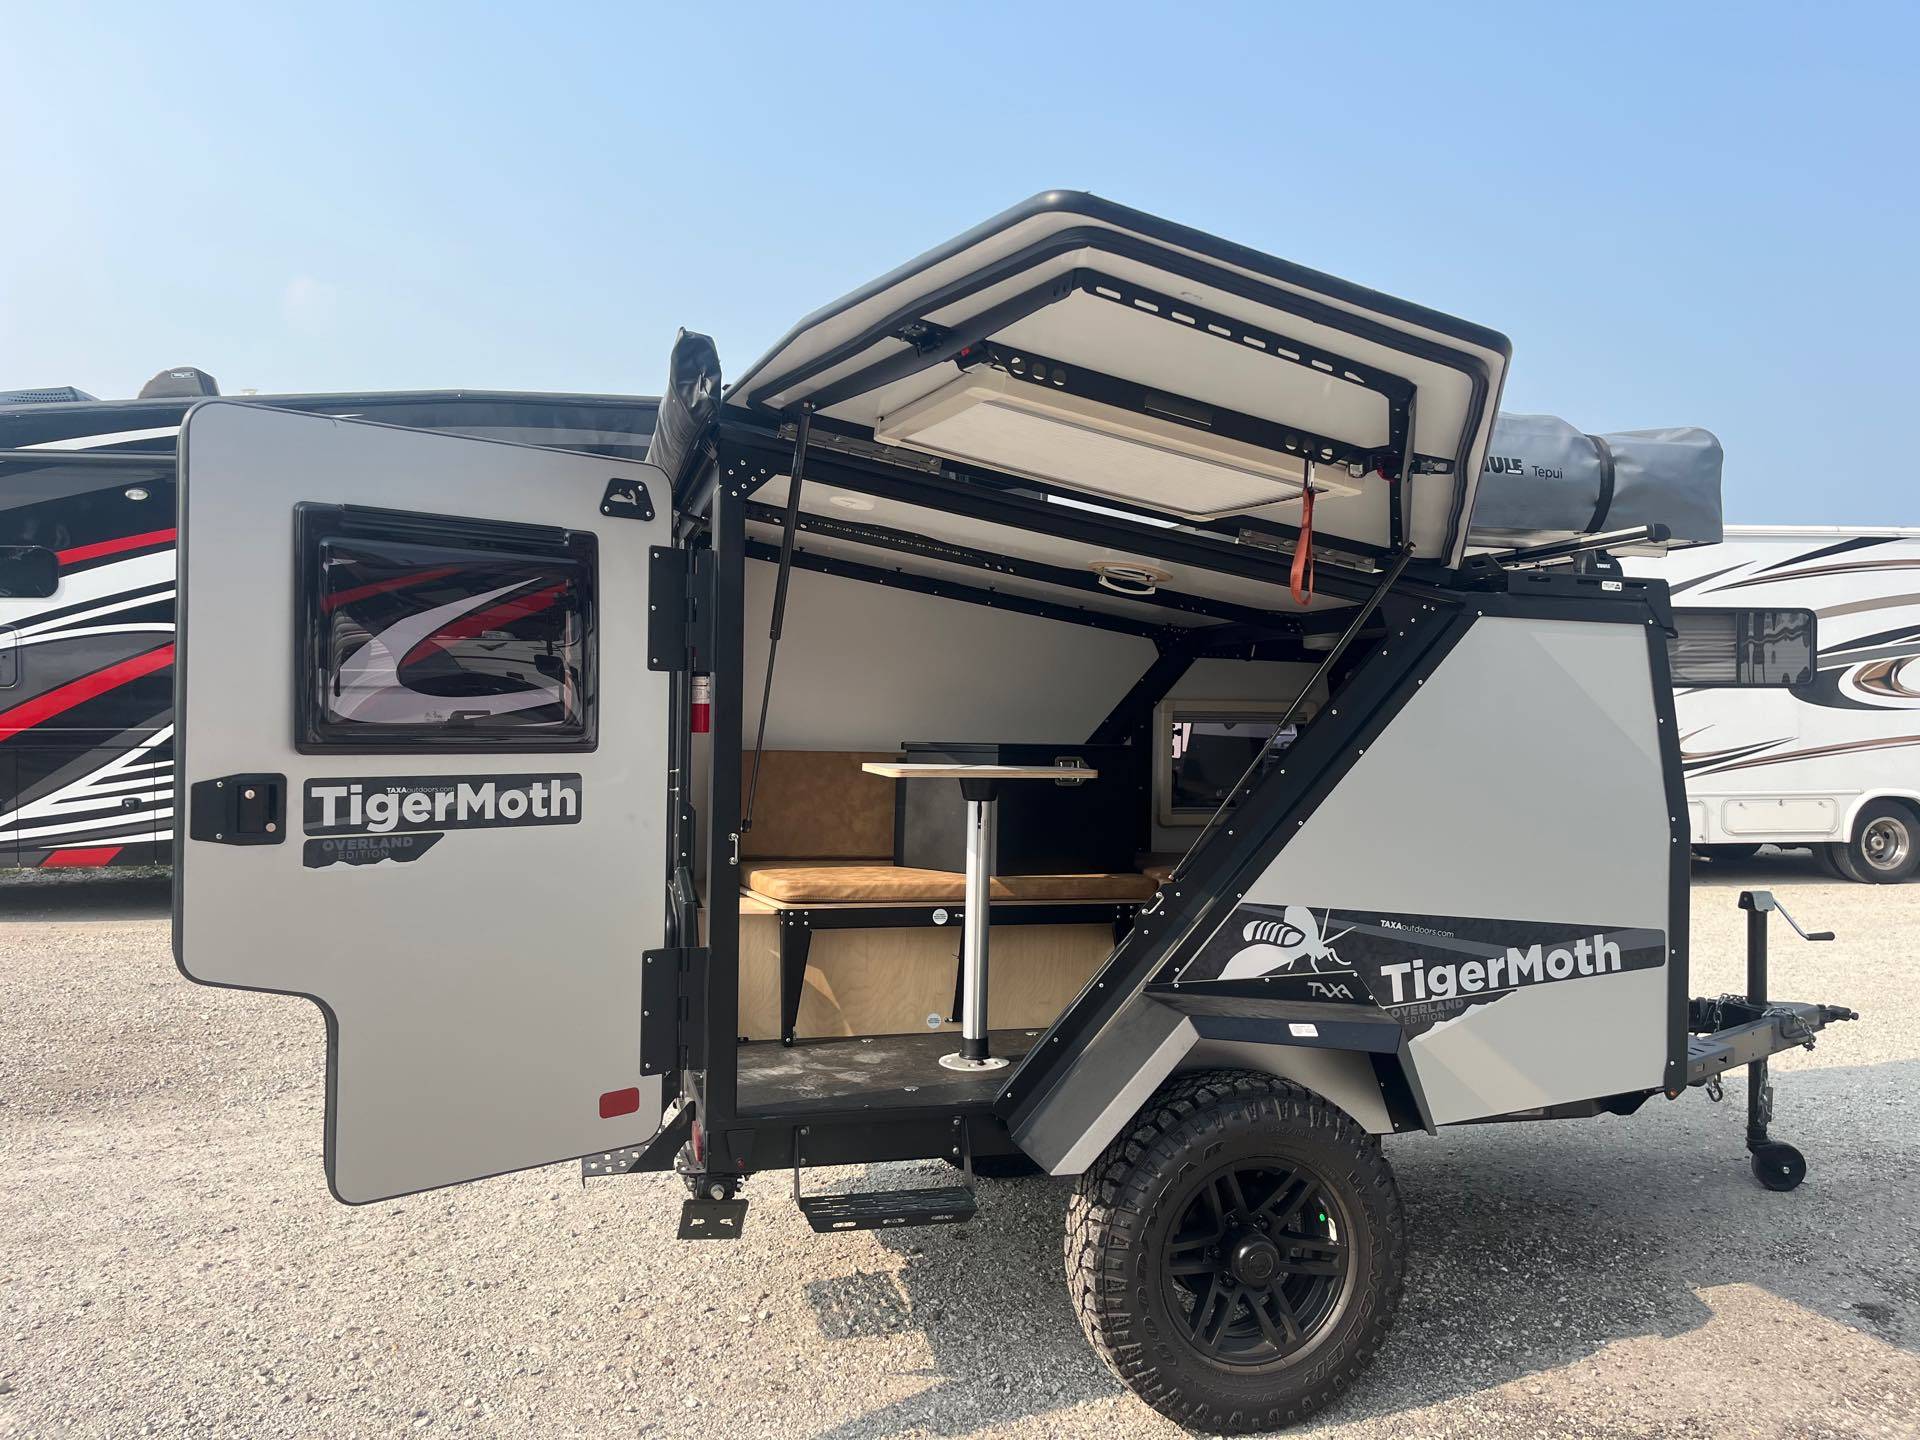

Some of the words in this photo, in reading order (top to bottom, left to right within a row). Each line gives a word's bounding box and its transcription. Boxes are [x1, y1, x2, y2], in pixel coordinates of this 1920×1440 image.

[1485, 456, 1523, 475] ULE
[1531, 465, 1563, 480] Tepui
[386, 786, 455, 794] TAXAoutdoors.com
[311, 779, 577, 832] TigerMoth
[322, 836, 413, 851] OVERLAND
[338, 849, 390, 860] EDITION
[1380, 919, 1455, 938] TAXAoutdoors.com
[1380, 934, 1622, 1003] TigerMoth
[1307, 981, 1354, 999] TAXA
[1391, 999, 1465, 1018] OVERLAND
[1404, 1012, 1445, 1025] EDITION
